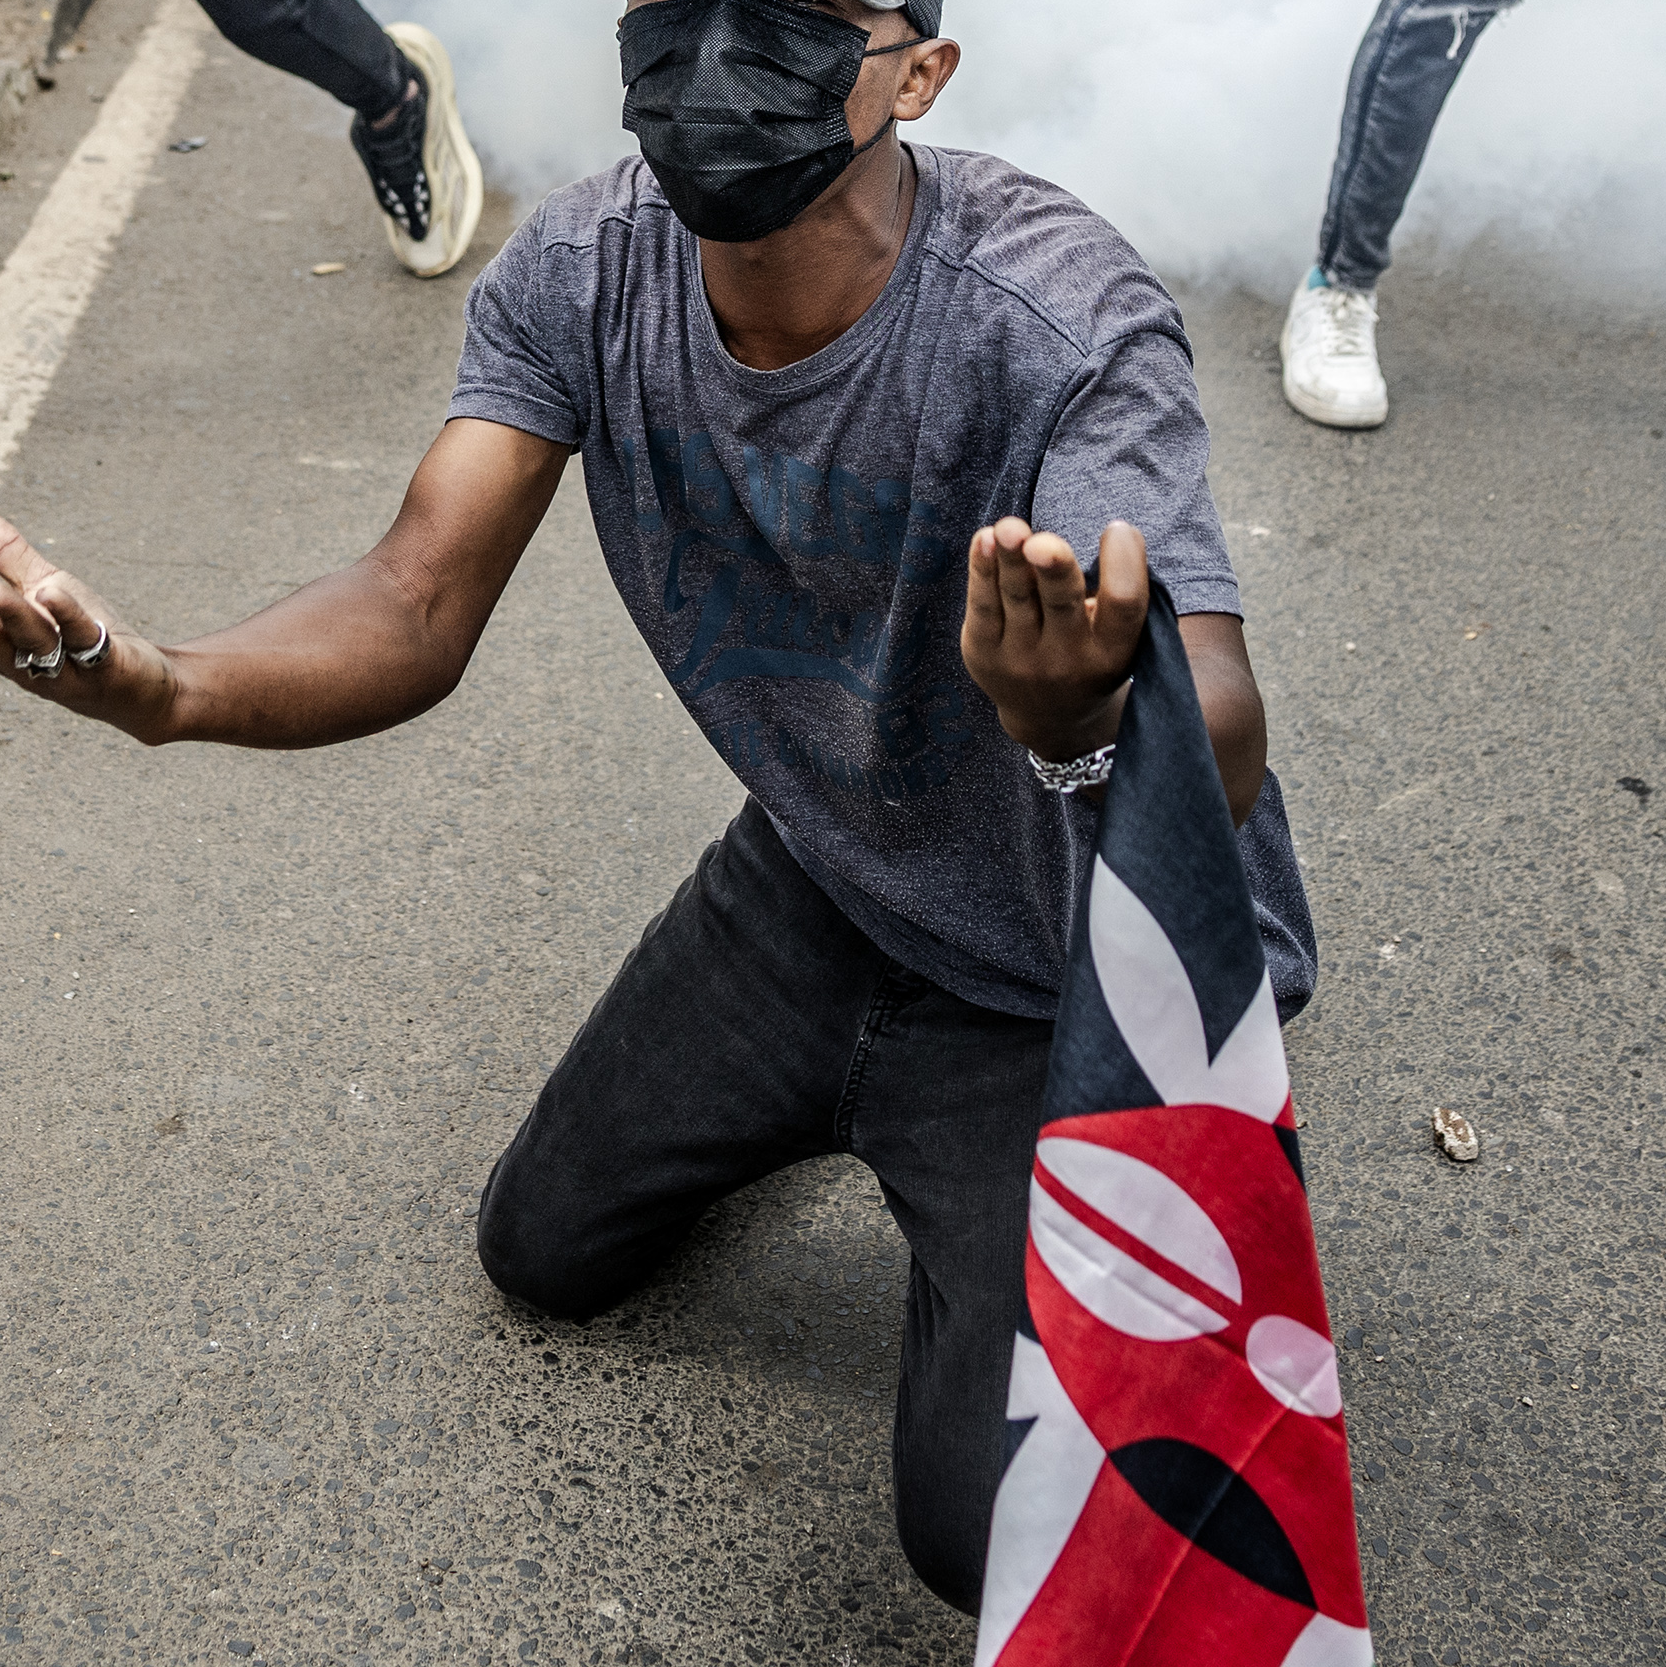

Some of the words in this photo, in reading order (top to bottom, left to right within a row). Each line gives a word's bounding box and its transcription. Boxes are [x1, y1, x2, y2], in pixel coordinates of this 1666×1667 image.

[622, 428, 735, 534] LAS
[742, 445, 950, 587] VEGAS
[876, 683, 974, 759] 82
